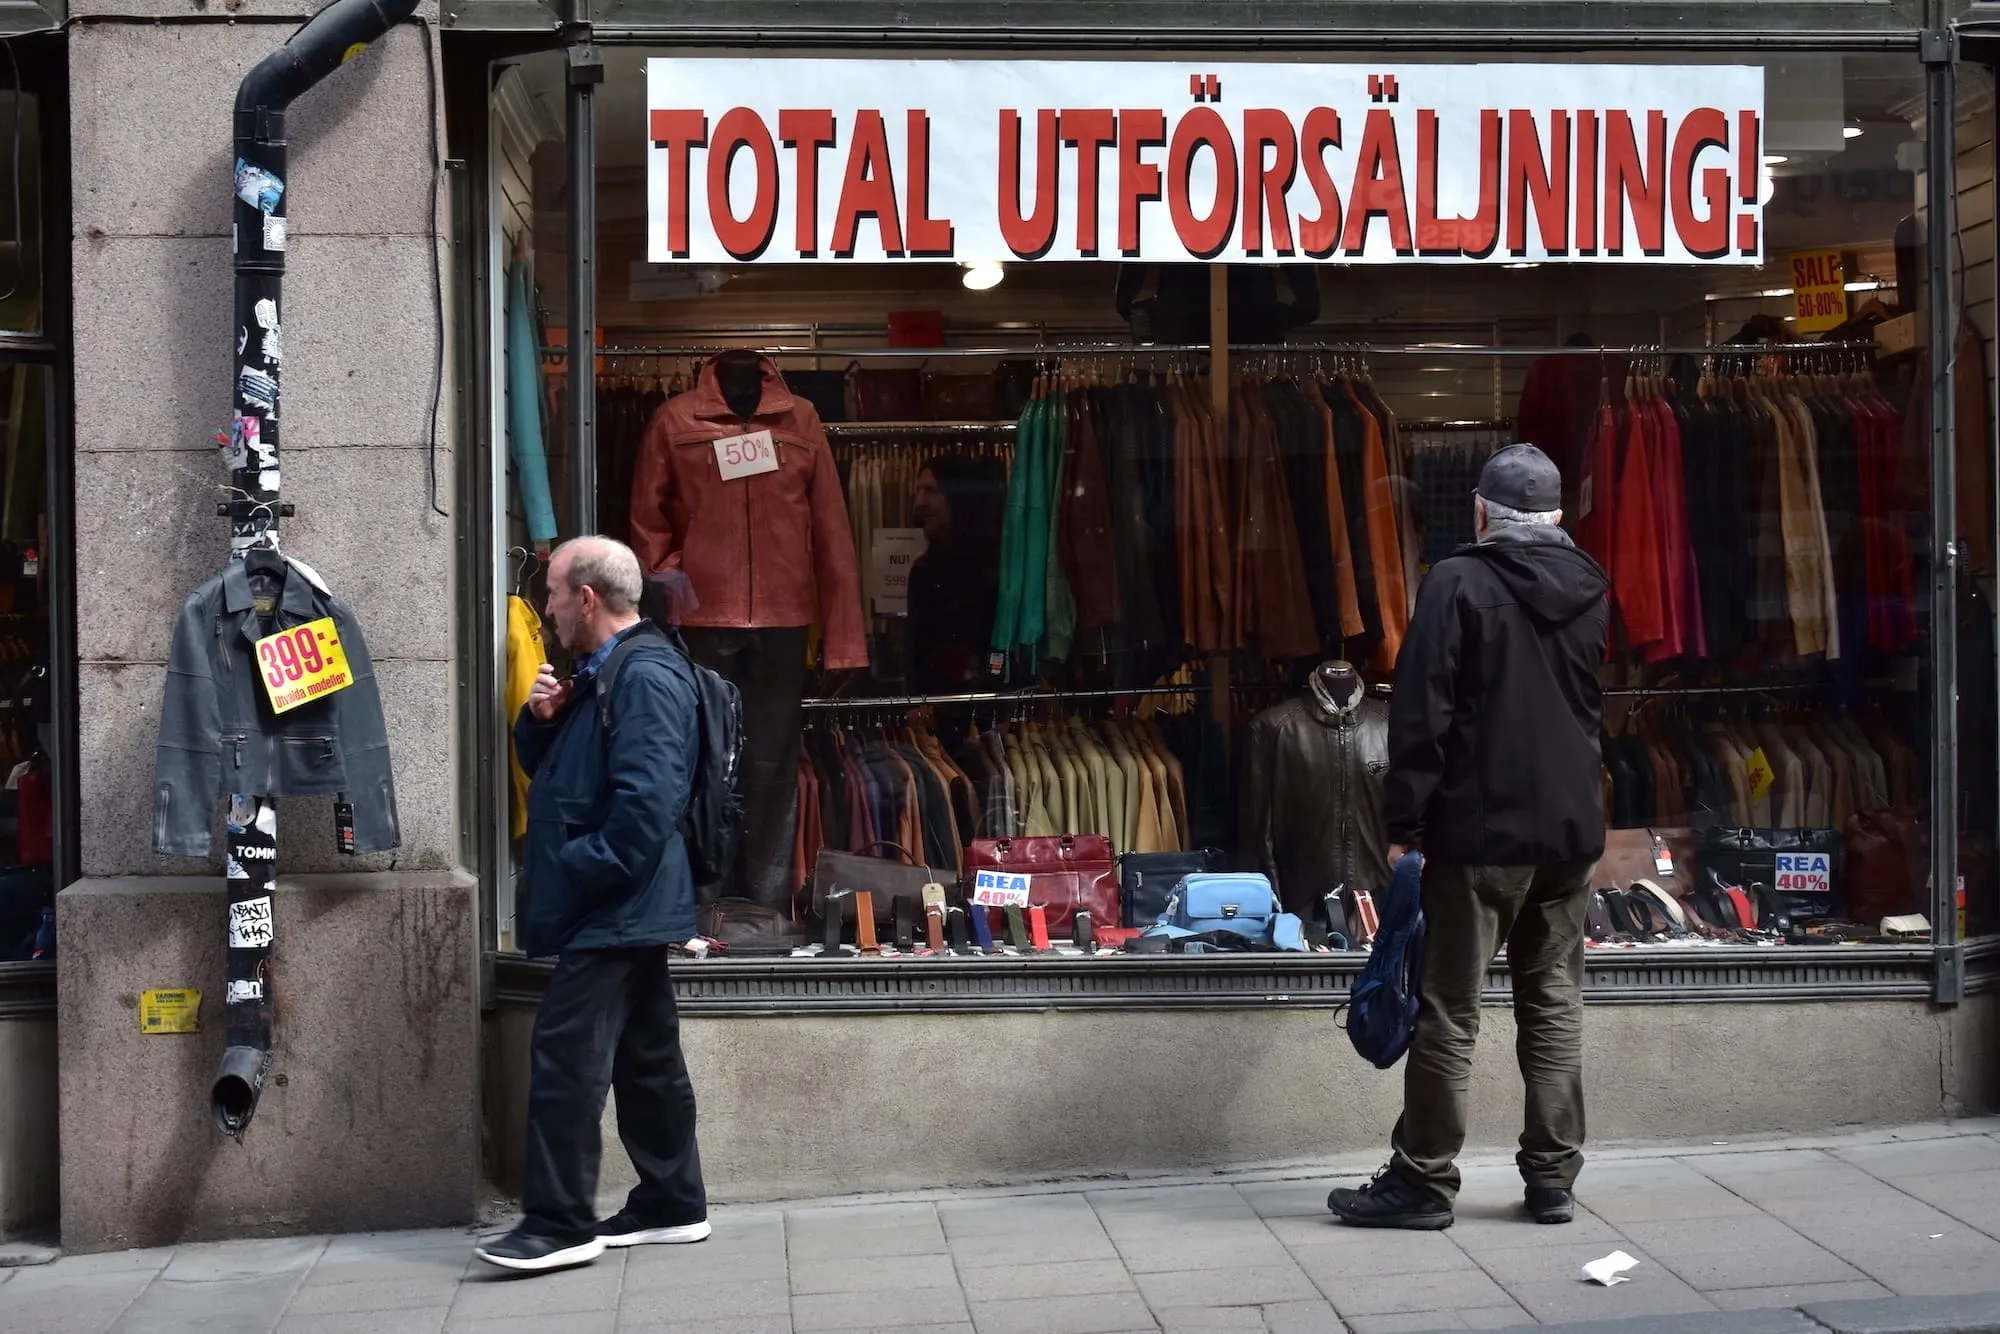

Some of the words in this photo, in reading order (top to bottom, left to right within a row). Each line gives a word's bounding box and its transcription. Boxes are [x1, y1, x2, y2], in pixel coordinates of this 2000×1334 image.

[650, 106, 954, 261] TOTAL
[998, 74, 1760, 261] UTFÖRSÄLJNING!
[1793, 254, 1840, 288] SALE
[1797, 291, 1843, 317] 50-80%
[726, 437, 770, 465] 50%
[260, 627, 338, 688] 399:-
[275, 687, 306, 709] Utvalda
[307, 672, 346, 696] modeller
[1776, 856, 1828, 872] REA
[977, 873, 1027, 891] REA
[1776, 874, 1828, 890] 40%
[977, 890, 1025, 907] 40%
